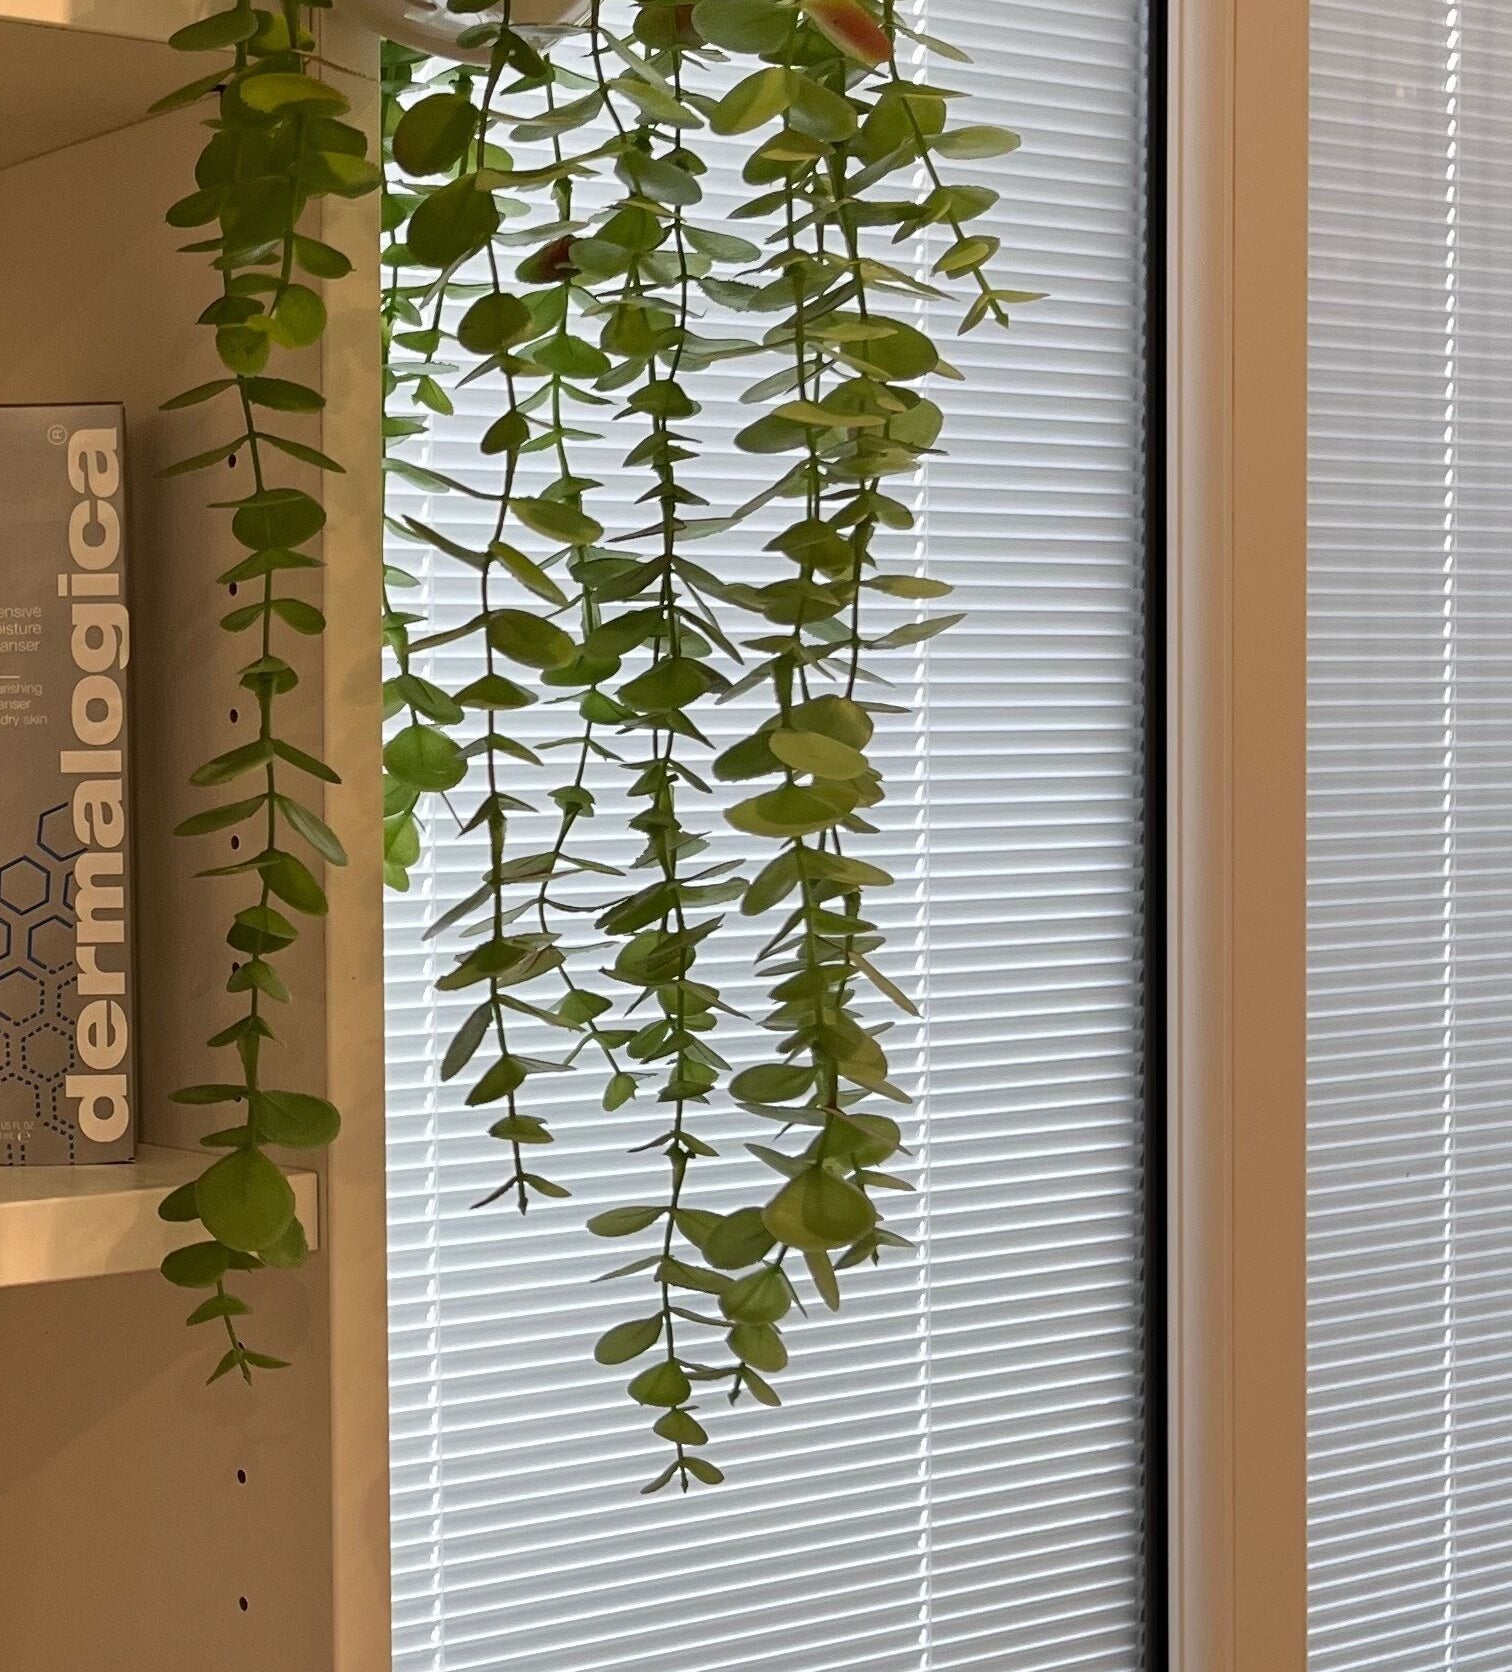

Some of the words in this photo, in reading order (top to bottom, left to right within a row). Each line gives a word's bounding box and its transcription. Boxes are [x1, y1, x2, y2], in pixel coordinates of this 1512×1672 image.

[0, 714, 19, 726] dry
[23, 714, 48, 725] skin
[57, 427, 130, 1143] dermalogica
